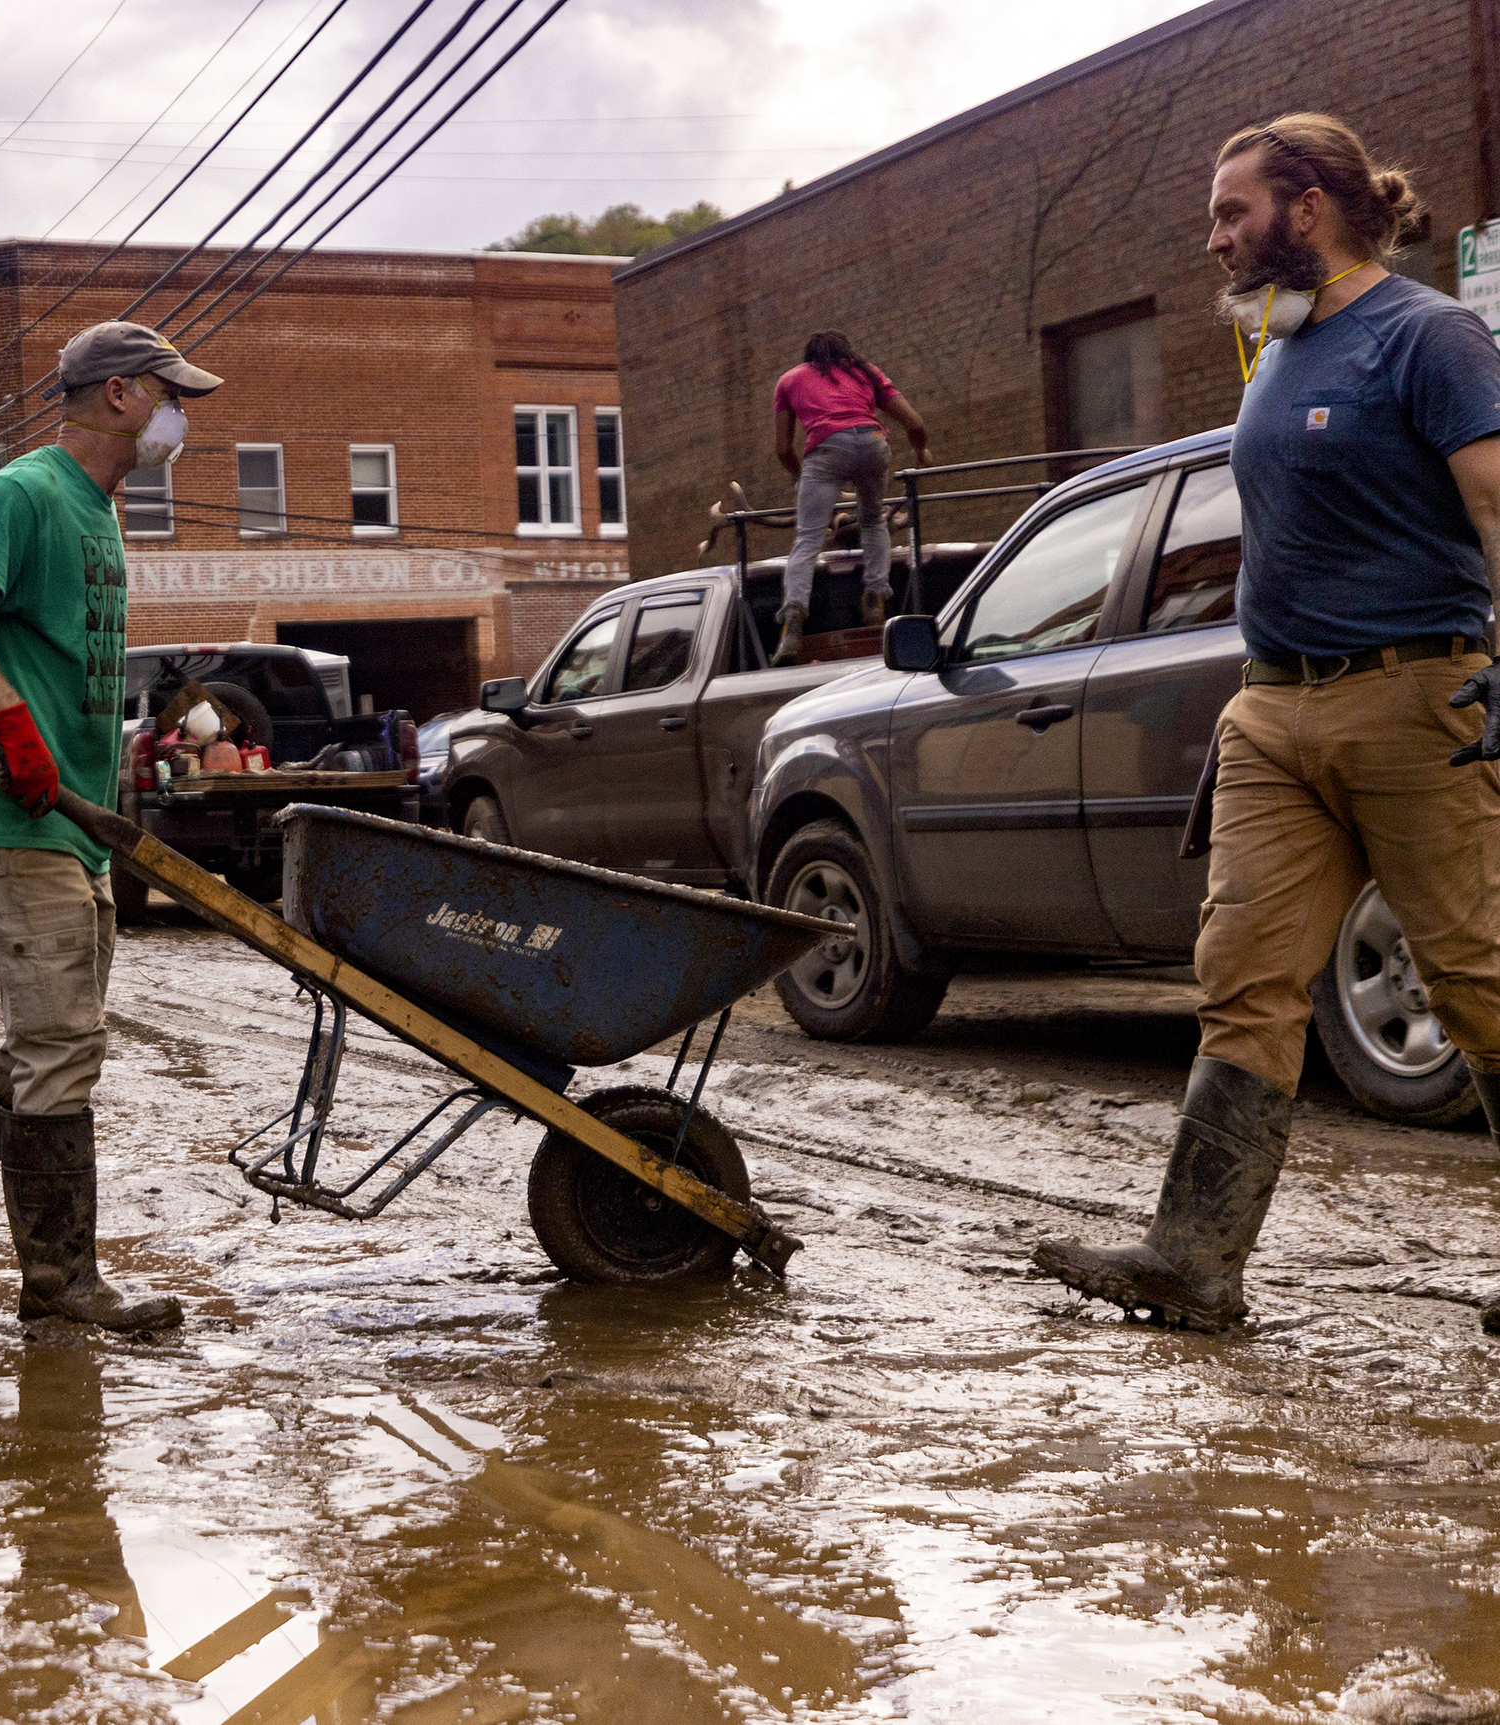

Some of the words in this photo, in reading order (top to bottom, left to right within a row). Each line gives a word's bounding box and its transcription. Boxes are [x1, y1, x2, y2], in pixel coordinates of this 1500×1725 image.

[1462, 234, 1476, 272] 2
[125, 559, 410, 592] INKLE-SHELTON
[431, 558, 488, 586] CO.
[534, 560, 630, 580] WHOL
[425, 902, 522, 943] Jackson
